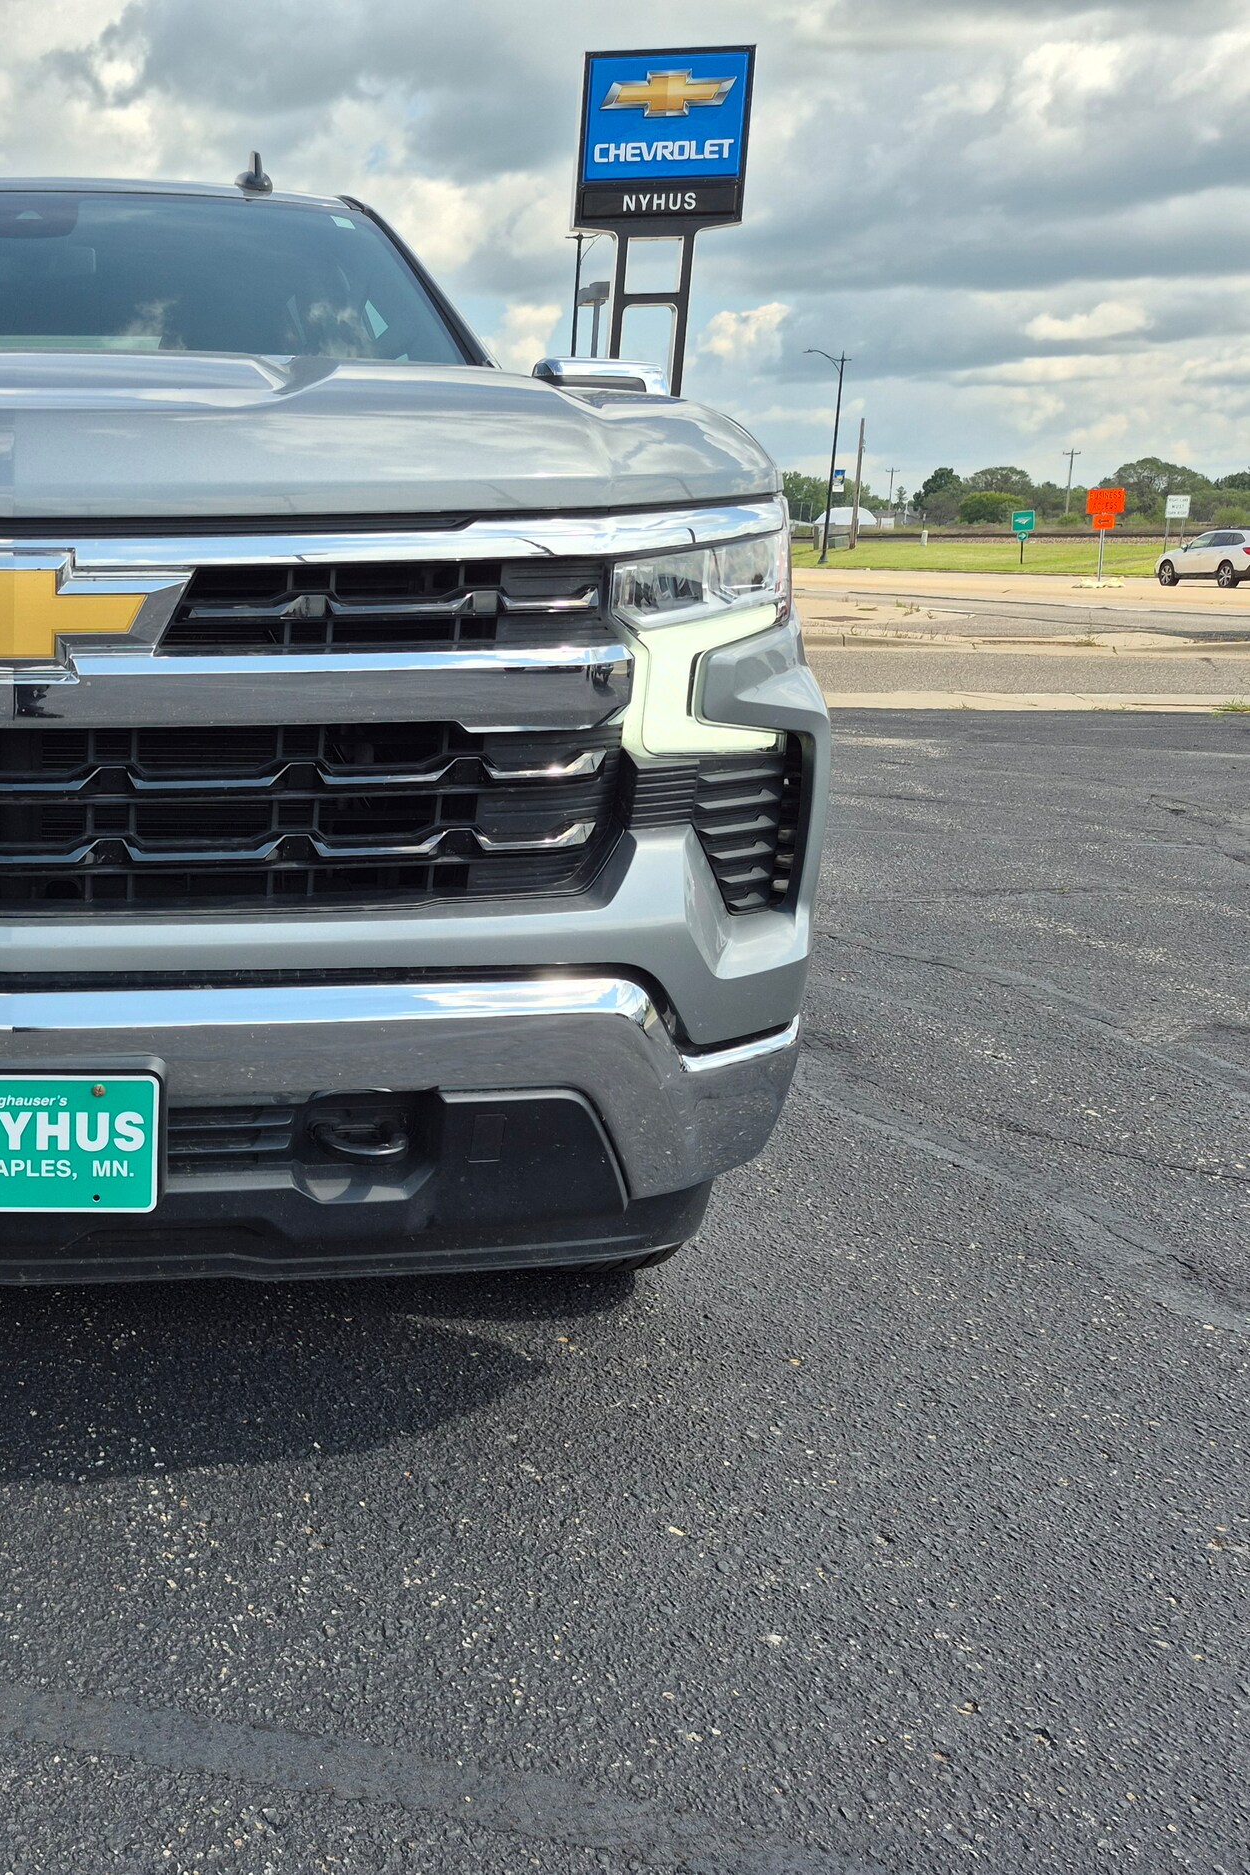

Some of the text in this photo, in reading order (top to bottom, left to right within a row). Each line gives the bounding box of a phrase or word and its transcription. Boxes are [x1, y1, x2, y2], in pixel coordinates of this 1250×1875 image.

[593, 138, 734, 163] CHEVROLET
[622, 192, 697, 212] NYHUS
[1089, 491, 1122, 500] BUSINESS
[1092, 501, 1118, 510] ACCESS
[92, 1160, 135, 1177] MN.
